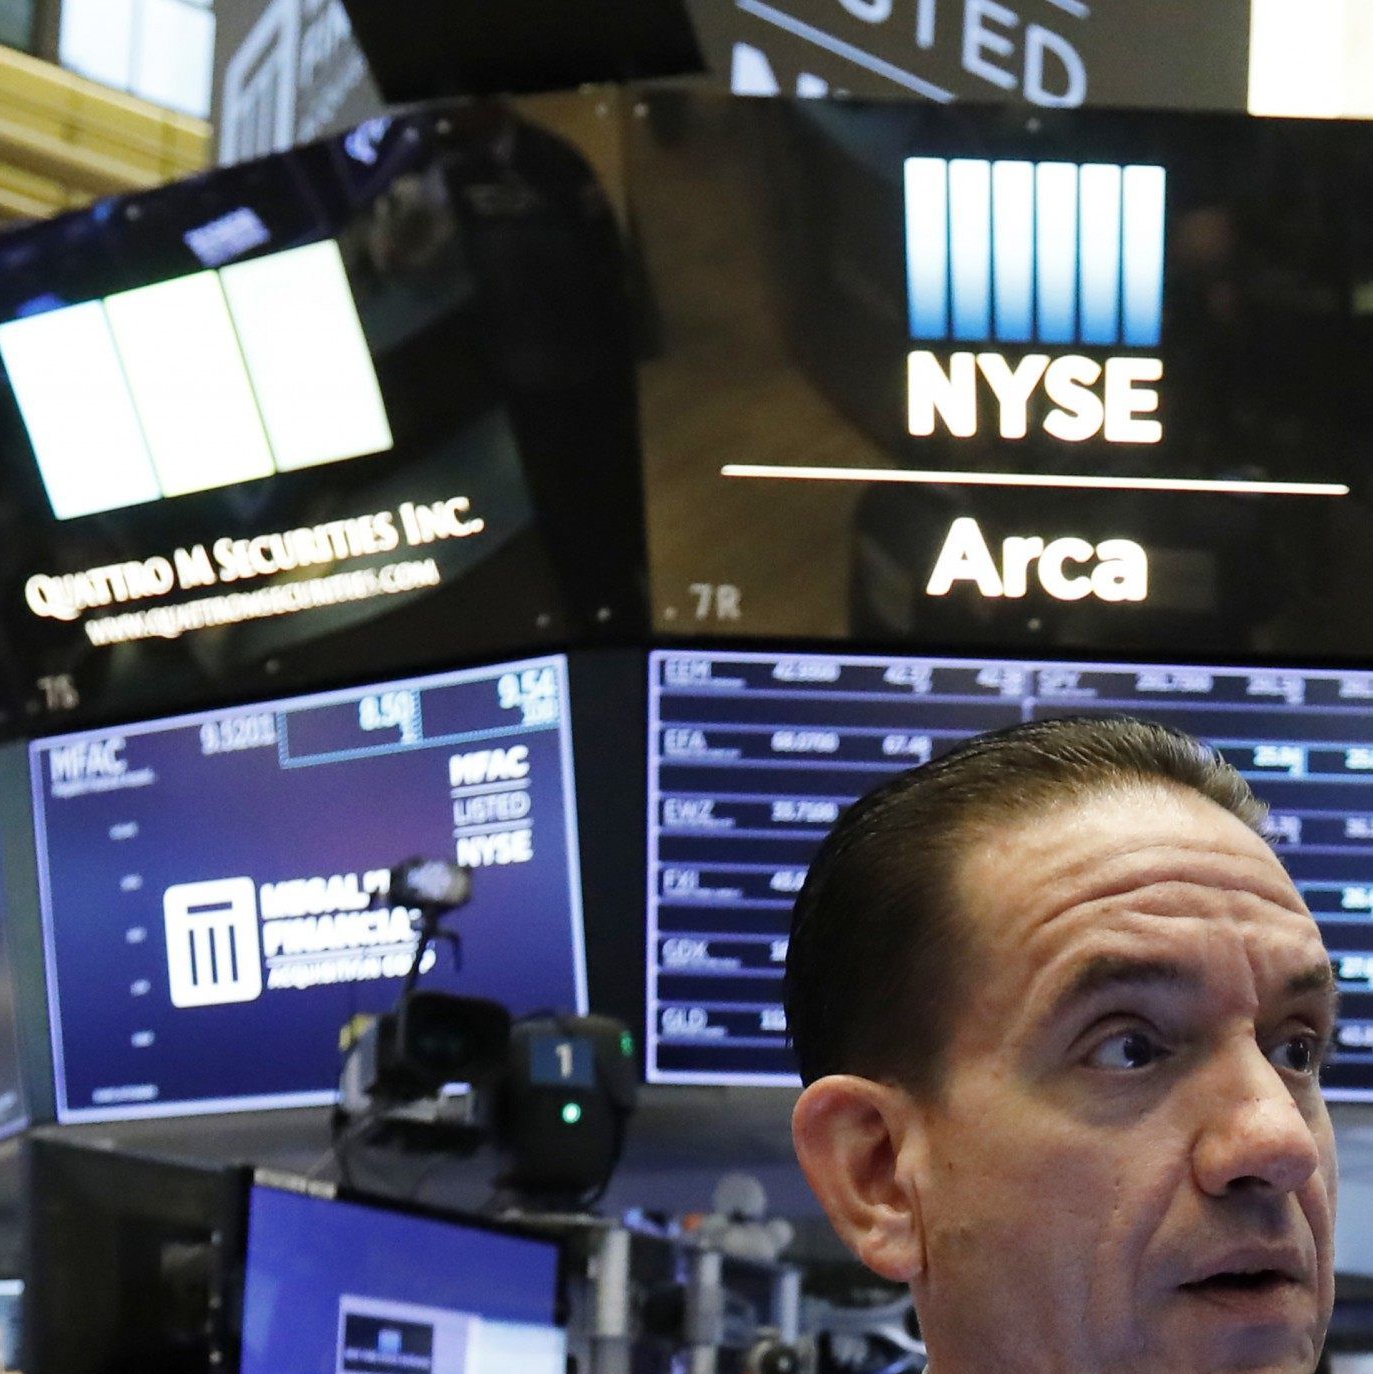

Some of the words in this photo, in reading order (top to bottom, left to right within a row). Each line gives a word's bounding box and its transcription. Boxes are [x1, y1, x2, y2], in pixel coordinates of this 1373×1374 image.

[907, 350, 1164, 443] NYSE
[926, 516, 1149, 602] Arca
[690, 582, 742, 620] 7R
[452, 790, 533, 827] LISTED
[456, 828, 535, 868] NYSE
[555, 1043, 574, 1078] 1
